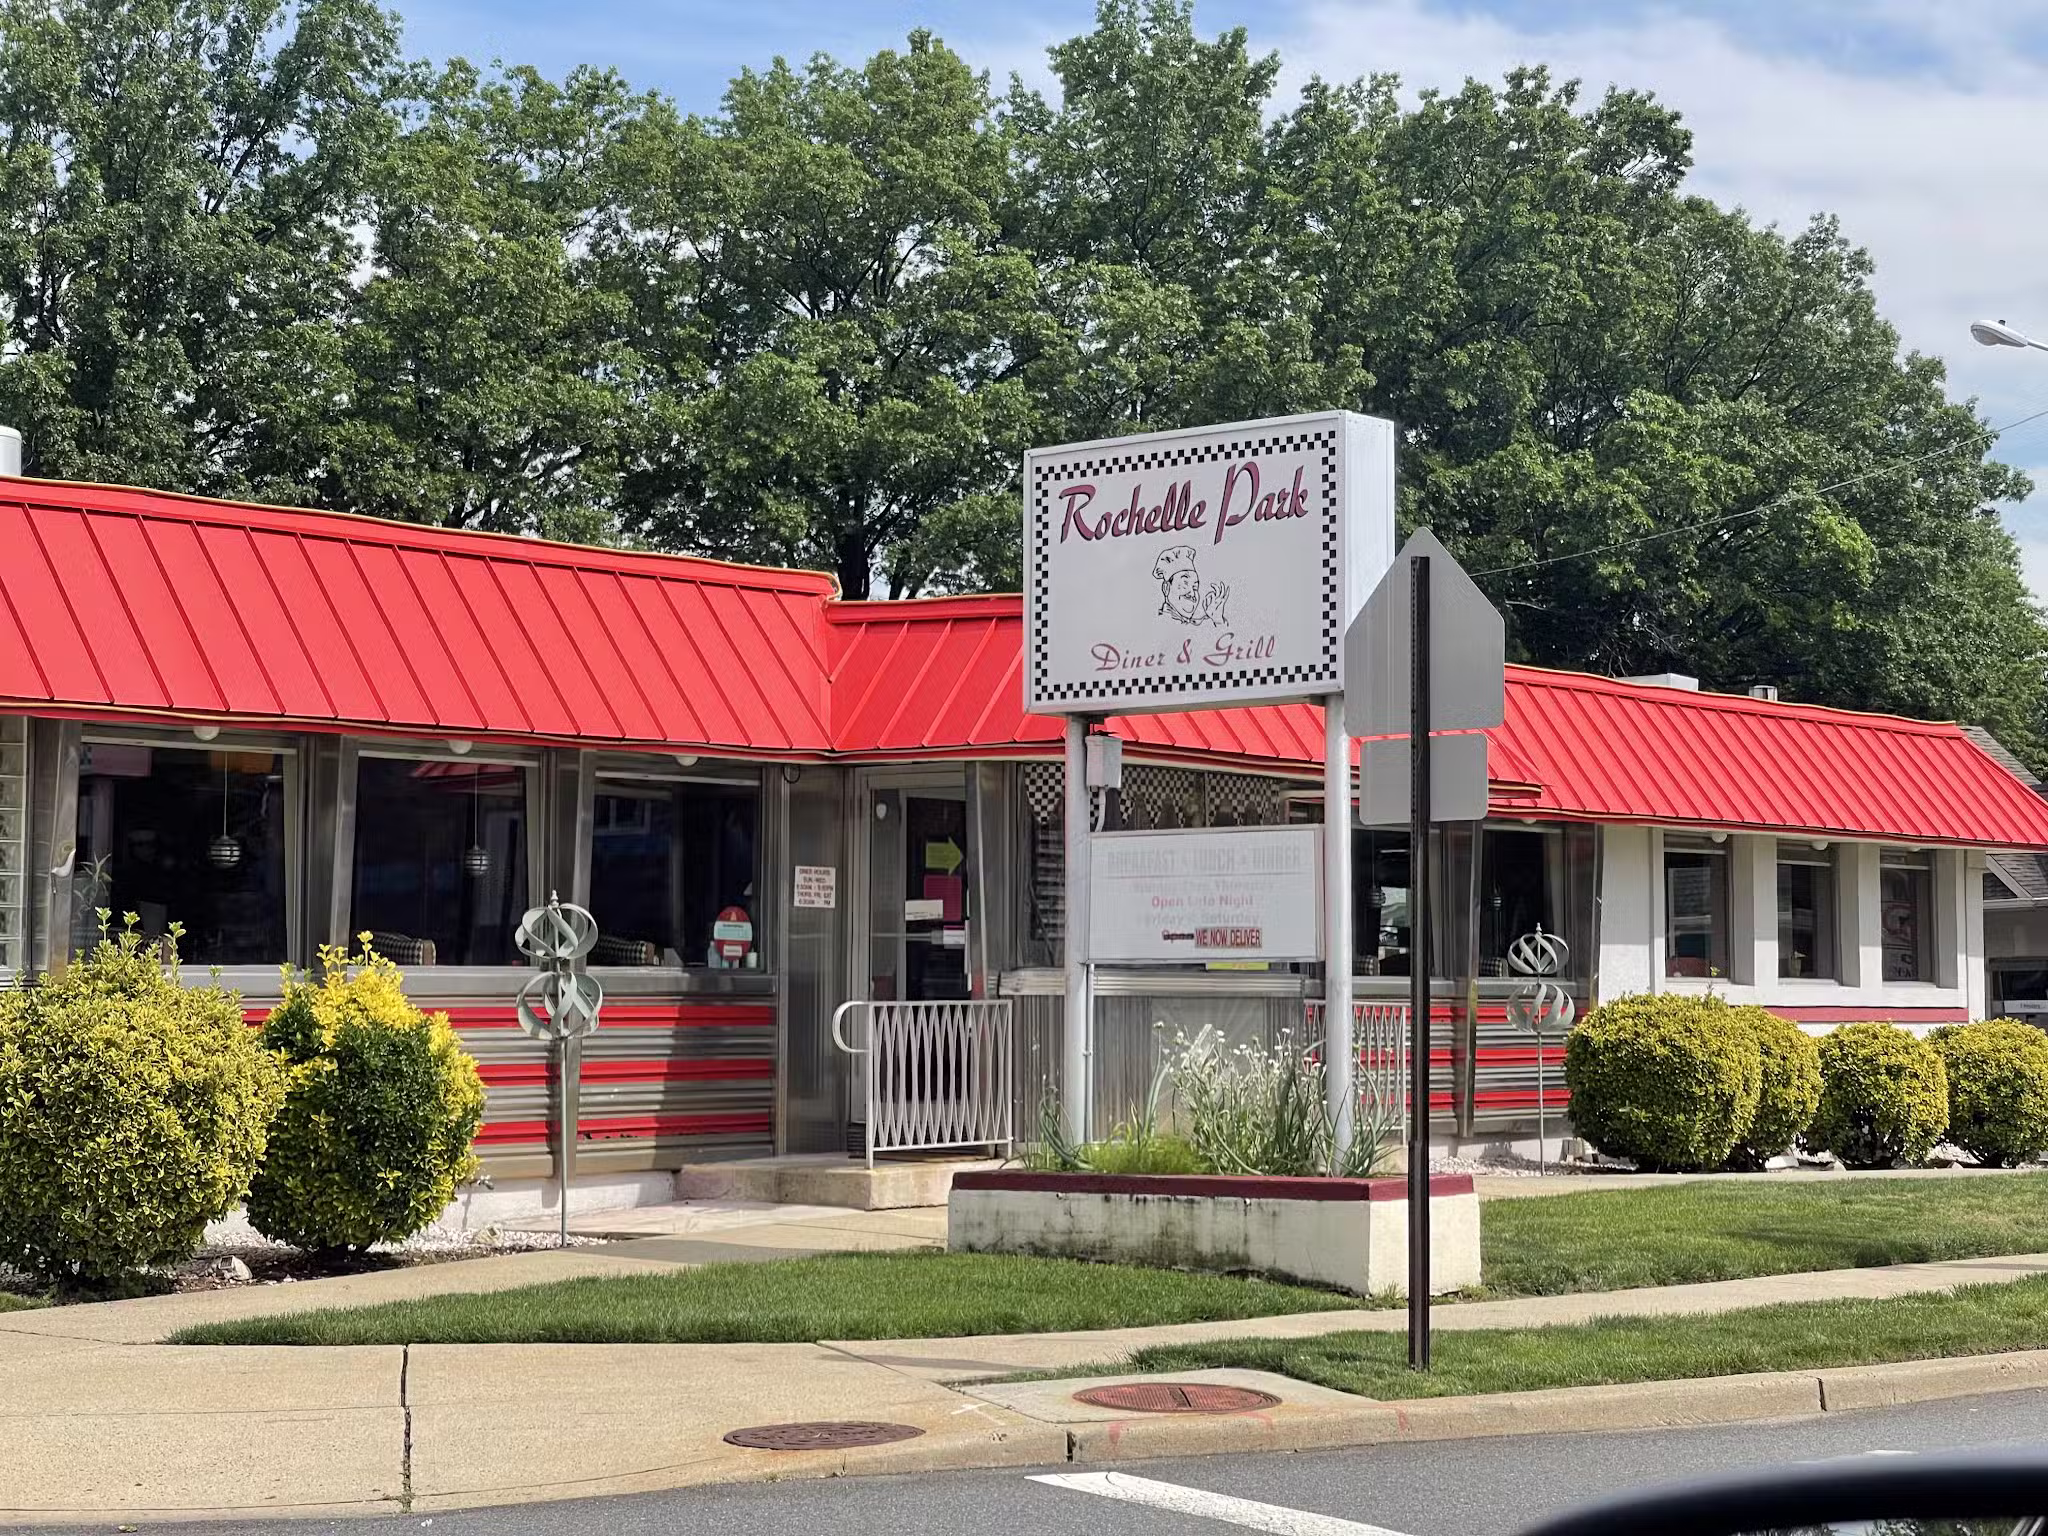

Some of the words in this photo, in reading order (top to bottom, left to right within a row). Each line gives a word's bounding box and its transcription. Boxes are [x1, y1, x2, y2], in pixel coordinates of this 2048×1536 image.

[1058, 480, 1207, 544] Rochelle
[1214, 461, 1309, 546] Park
[1091, 643, 1166, 671] Diner
[1176, 638, 1193, 664] &
[1203, 632, 1275, 667] Grill
[1152, 896, 1183, 909] Open
[1219, 895, 1254, 908] Night
[1195, 928, 1207, 945] WE
[1210, 928, 1228, 945] NOW
[1231, 928, 1261, 946] DELIVER
